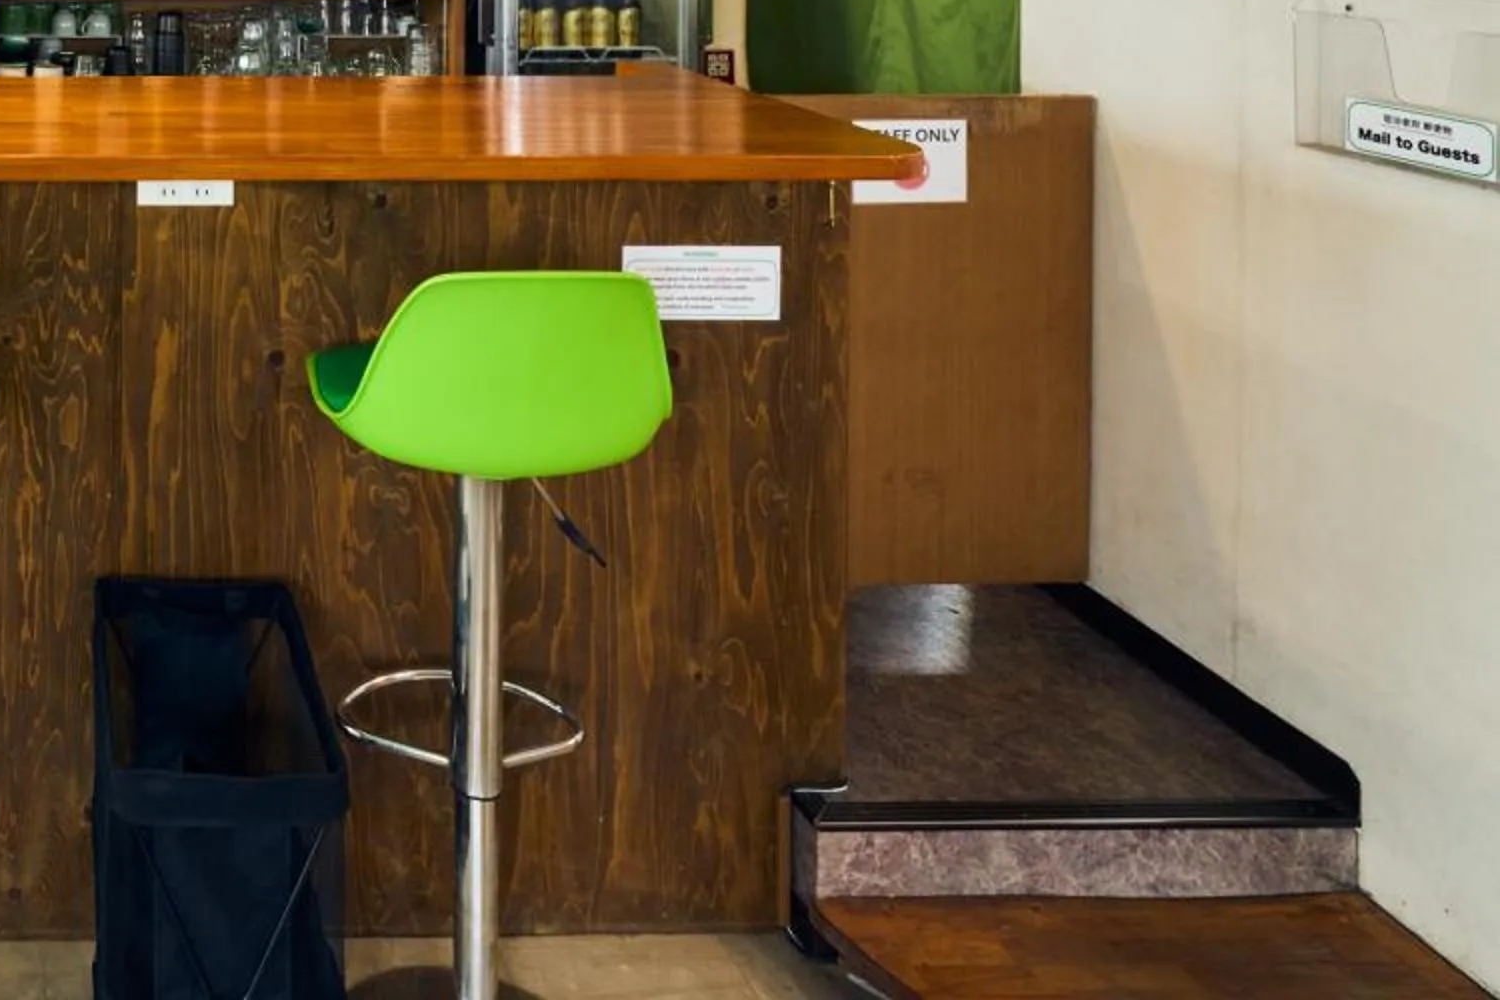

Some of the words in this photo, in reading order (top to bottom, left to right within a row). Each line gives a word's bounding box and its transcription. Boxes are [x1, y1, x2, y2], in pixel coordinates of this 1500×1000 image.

[914, 128, 960, 142] ONLY
[1358, 126, 1391, 145] Mail
[1396, 135, 1413, 151] to
[1417, 139, 1481, 165] Guests
